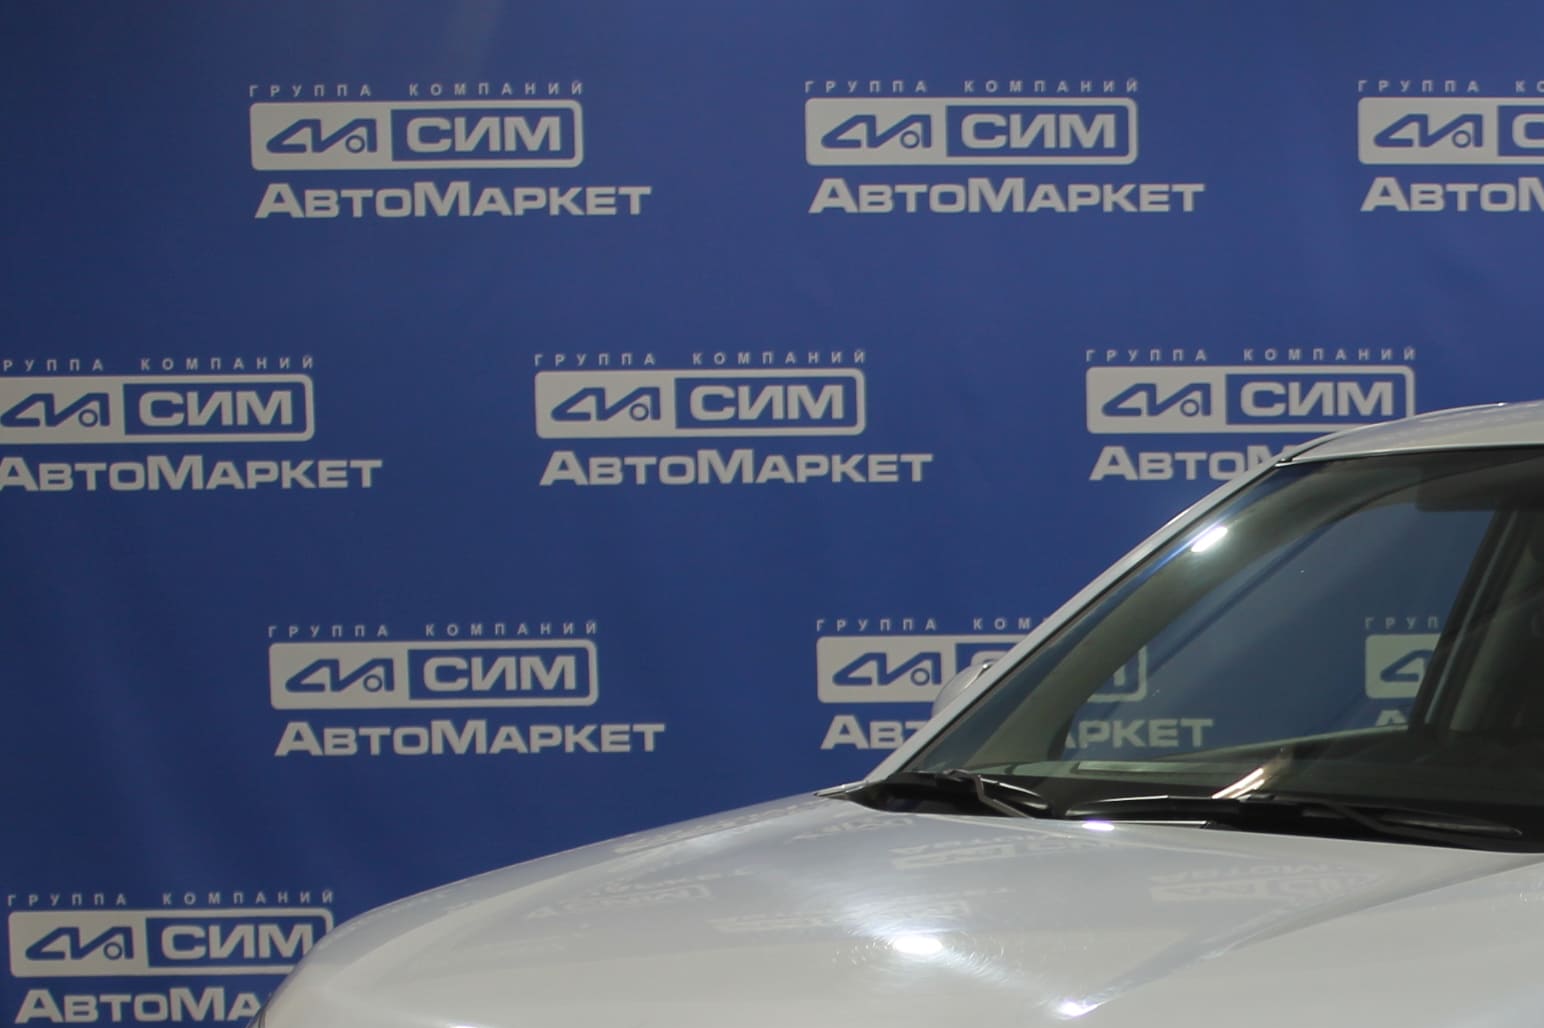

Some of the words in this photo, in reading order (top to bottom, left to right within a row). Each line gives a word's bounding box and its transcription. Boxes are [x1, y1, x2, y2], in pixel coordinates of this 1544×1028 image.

[250, 84, 371, 96] ГРУППА
[409, 80, 582, 96] КОМПАНИЙ
[805, 80, 926, 92] ГРУППА
[964, 79, 1137, 92] КОМПАНИЙ
[1358, 80, 1478, 92] ГРУППА
[407, 116, 560, 152] СИМ
[961, 114, 1115, 148] СИМ
[535, 353, 654, 366] ГРУППА
[693, 350, 864, 364] КОМПАНИЙ
[1086, 349, 1206, 361] ГРУППА
[1244, 347, 1415, 360] КОМПАНИЙ
[3, 359, 102, 371] РУППА
[141, 355, 312, 370] КОМПАНИЙ
[690, 385, 843, 420] СИМ
[1241, 381, 1393, 417] СИМ
[139, 390, 292, 426] СИМ
[268, 625, 387, 637] ГРУППА
[426, 621, 596, 636] КОМПАНИЙ
[817, 618, 936, 631] ГРУППА
[1364, 616, 1439, 630] ГРУП
[424, 656, 575, 691] СИМ
[7, 893, 125, 906] ГРУППА
[163, 890, 333, 905] КОМПАНИЙ
[161, 924, 313, 960] СИМ
